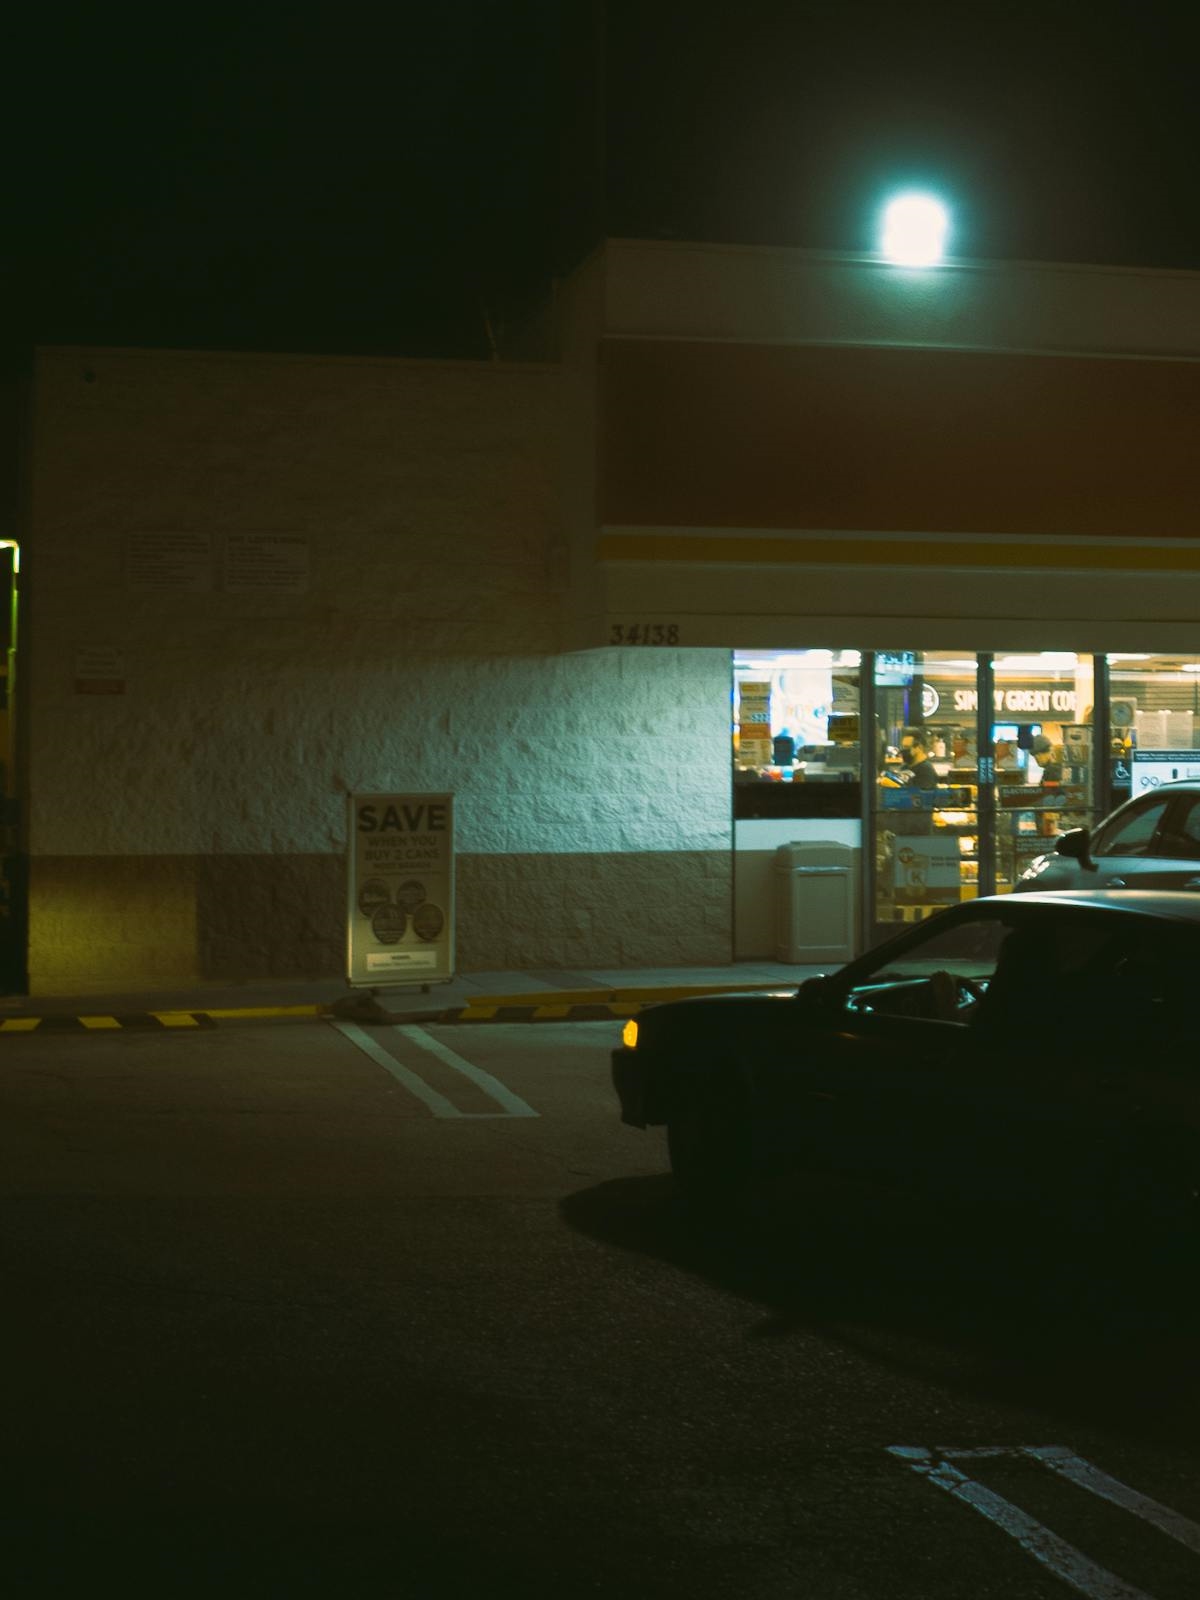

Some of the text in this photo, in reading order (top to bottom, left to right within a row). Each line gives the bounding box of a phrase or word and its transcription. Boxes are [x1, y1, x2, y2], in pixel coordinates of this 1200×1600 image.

[610, 624, 679, 645] 34138
[358, 805, 446, 832] SAVE
[368, 835, 437, 847] WHEN YOU
